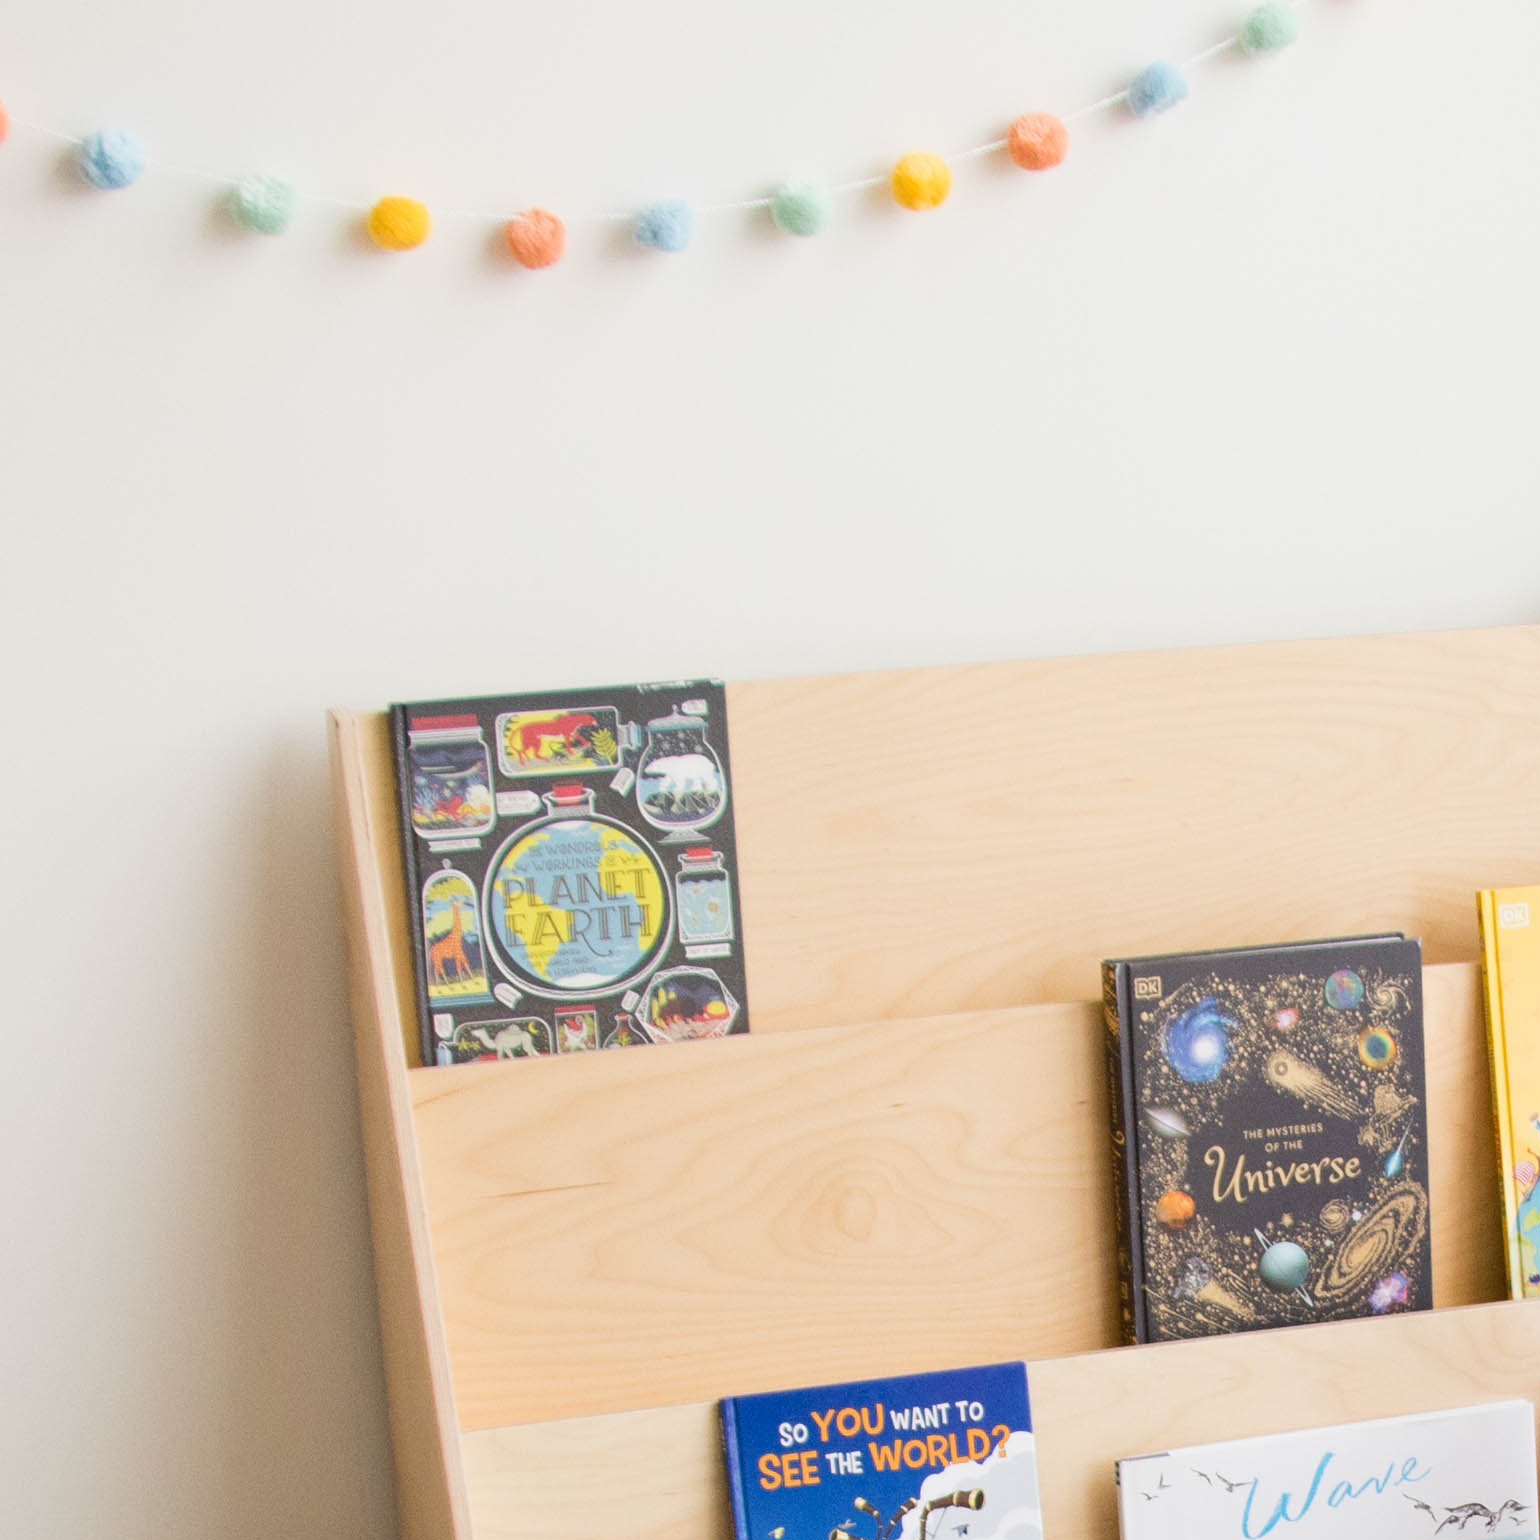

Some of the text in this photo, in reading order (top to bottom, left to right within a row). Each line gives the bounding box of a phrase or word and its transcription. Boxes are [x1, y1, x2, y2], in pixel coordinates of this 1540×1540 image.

[503, 869, 650, 909] PLANET
[505, 904, 652, 956] EARTH
[1136, 978, 1161, 997] DK
[1243, 1123, 1323, 1140] THE MYSTERIES
[1265, 1140, 1303, 1152] OF THE
[1204, 1145, 1361, 1202] Universe
[811, 1403, 884, 1442] YOU
[890, 1402, 951, 1431] WANT
[954, 1400, 984, 1422] TO
[758, 1424, 1011, 1490] SEE THE WORLD?
[1242, 1451, 1431, 1540] Wave
